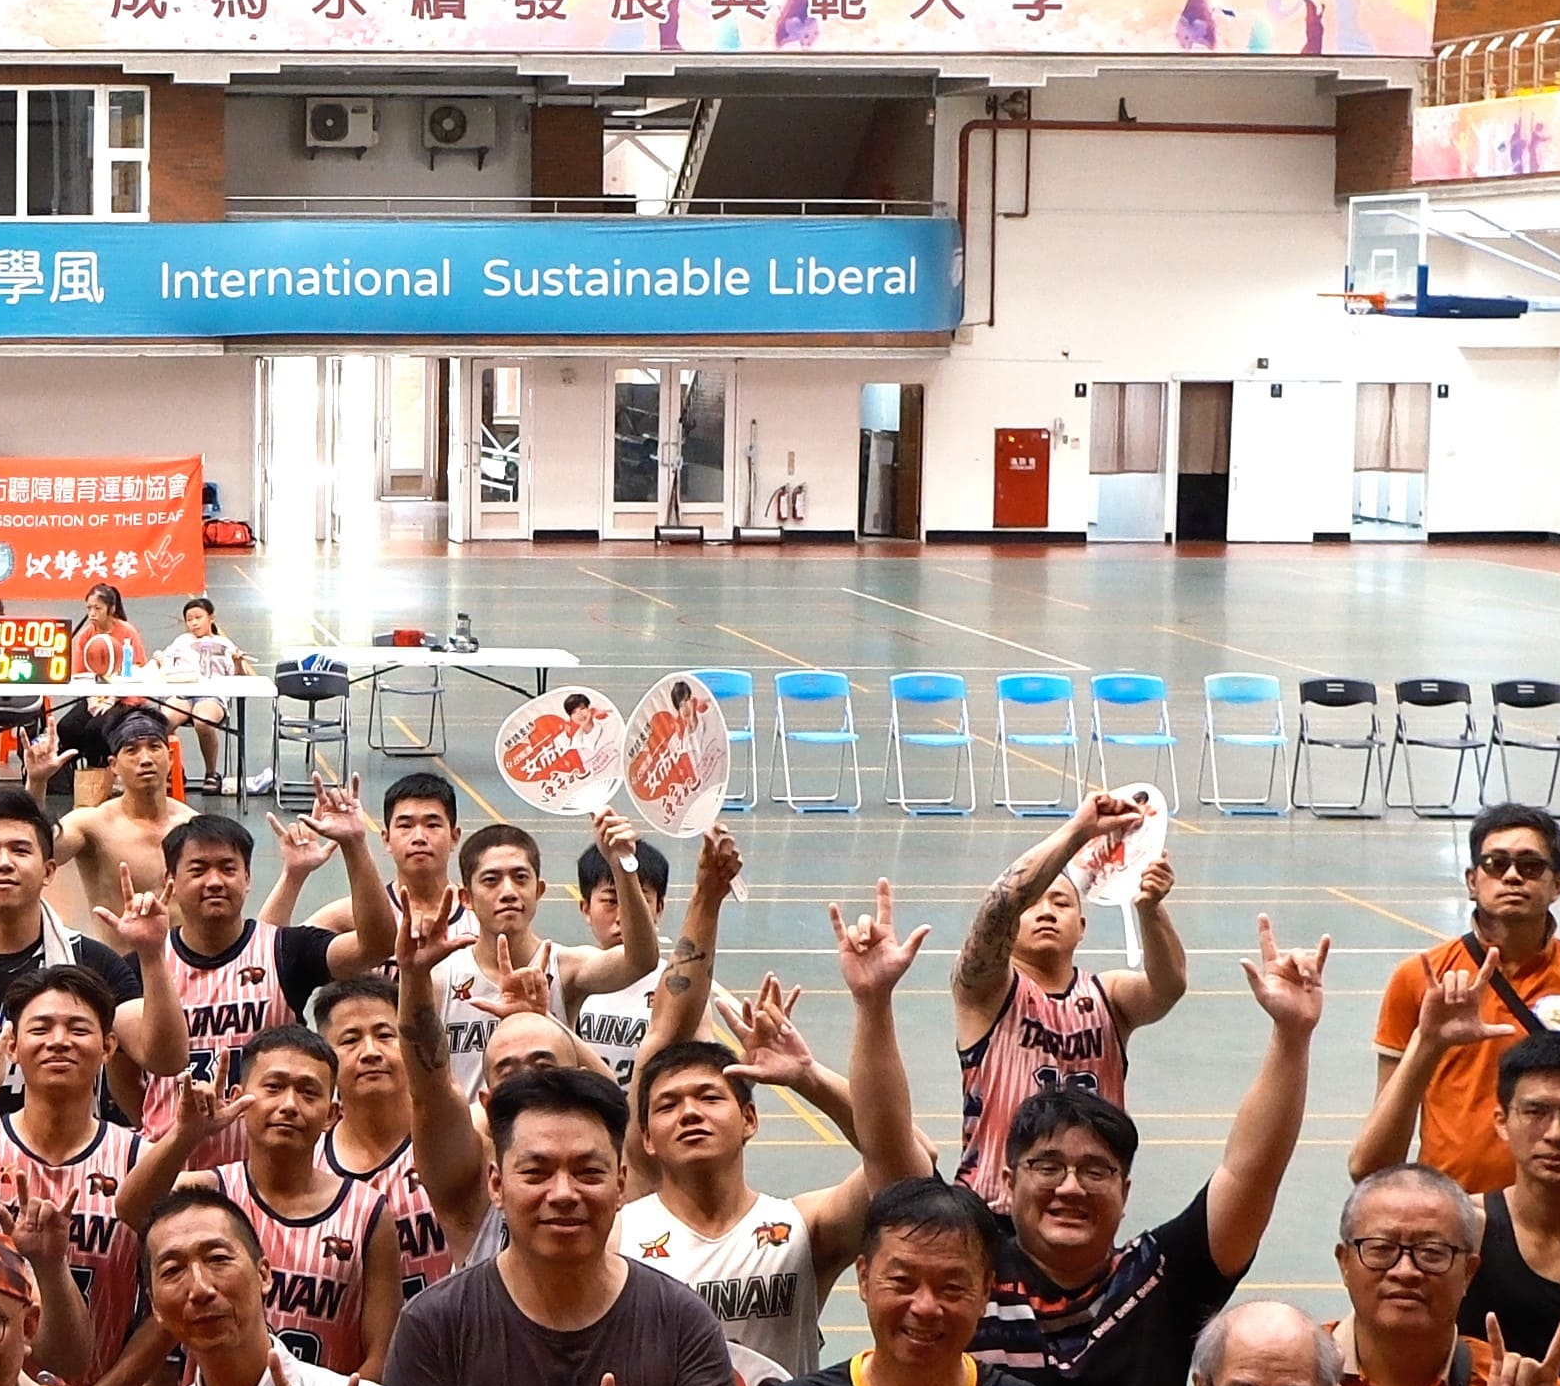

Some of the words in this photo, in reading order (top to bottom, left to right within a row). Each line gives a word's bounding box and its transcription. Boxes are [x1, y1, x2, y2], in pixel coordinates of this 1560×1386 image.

[161, 258, 451, 299] International
[482, 258, 750, 299] Sustainable
[768, 256, 917, 297] Liberal
[88, 514, 108, 528] OF
[113, 513, 142, 527] THE
[147, 509, 184, 525] DEAF
